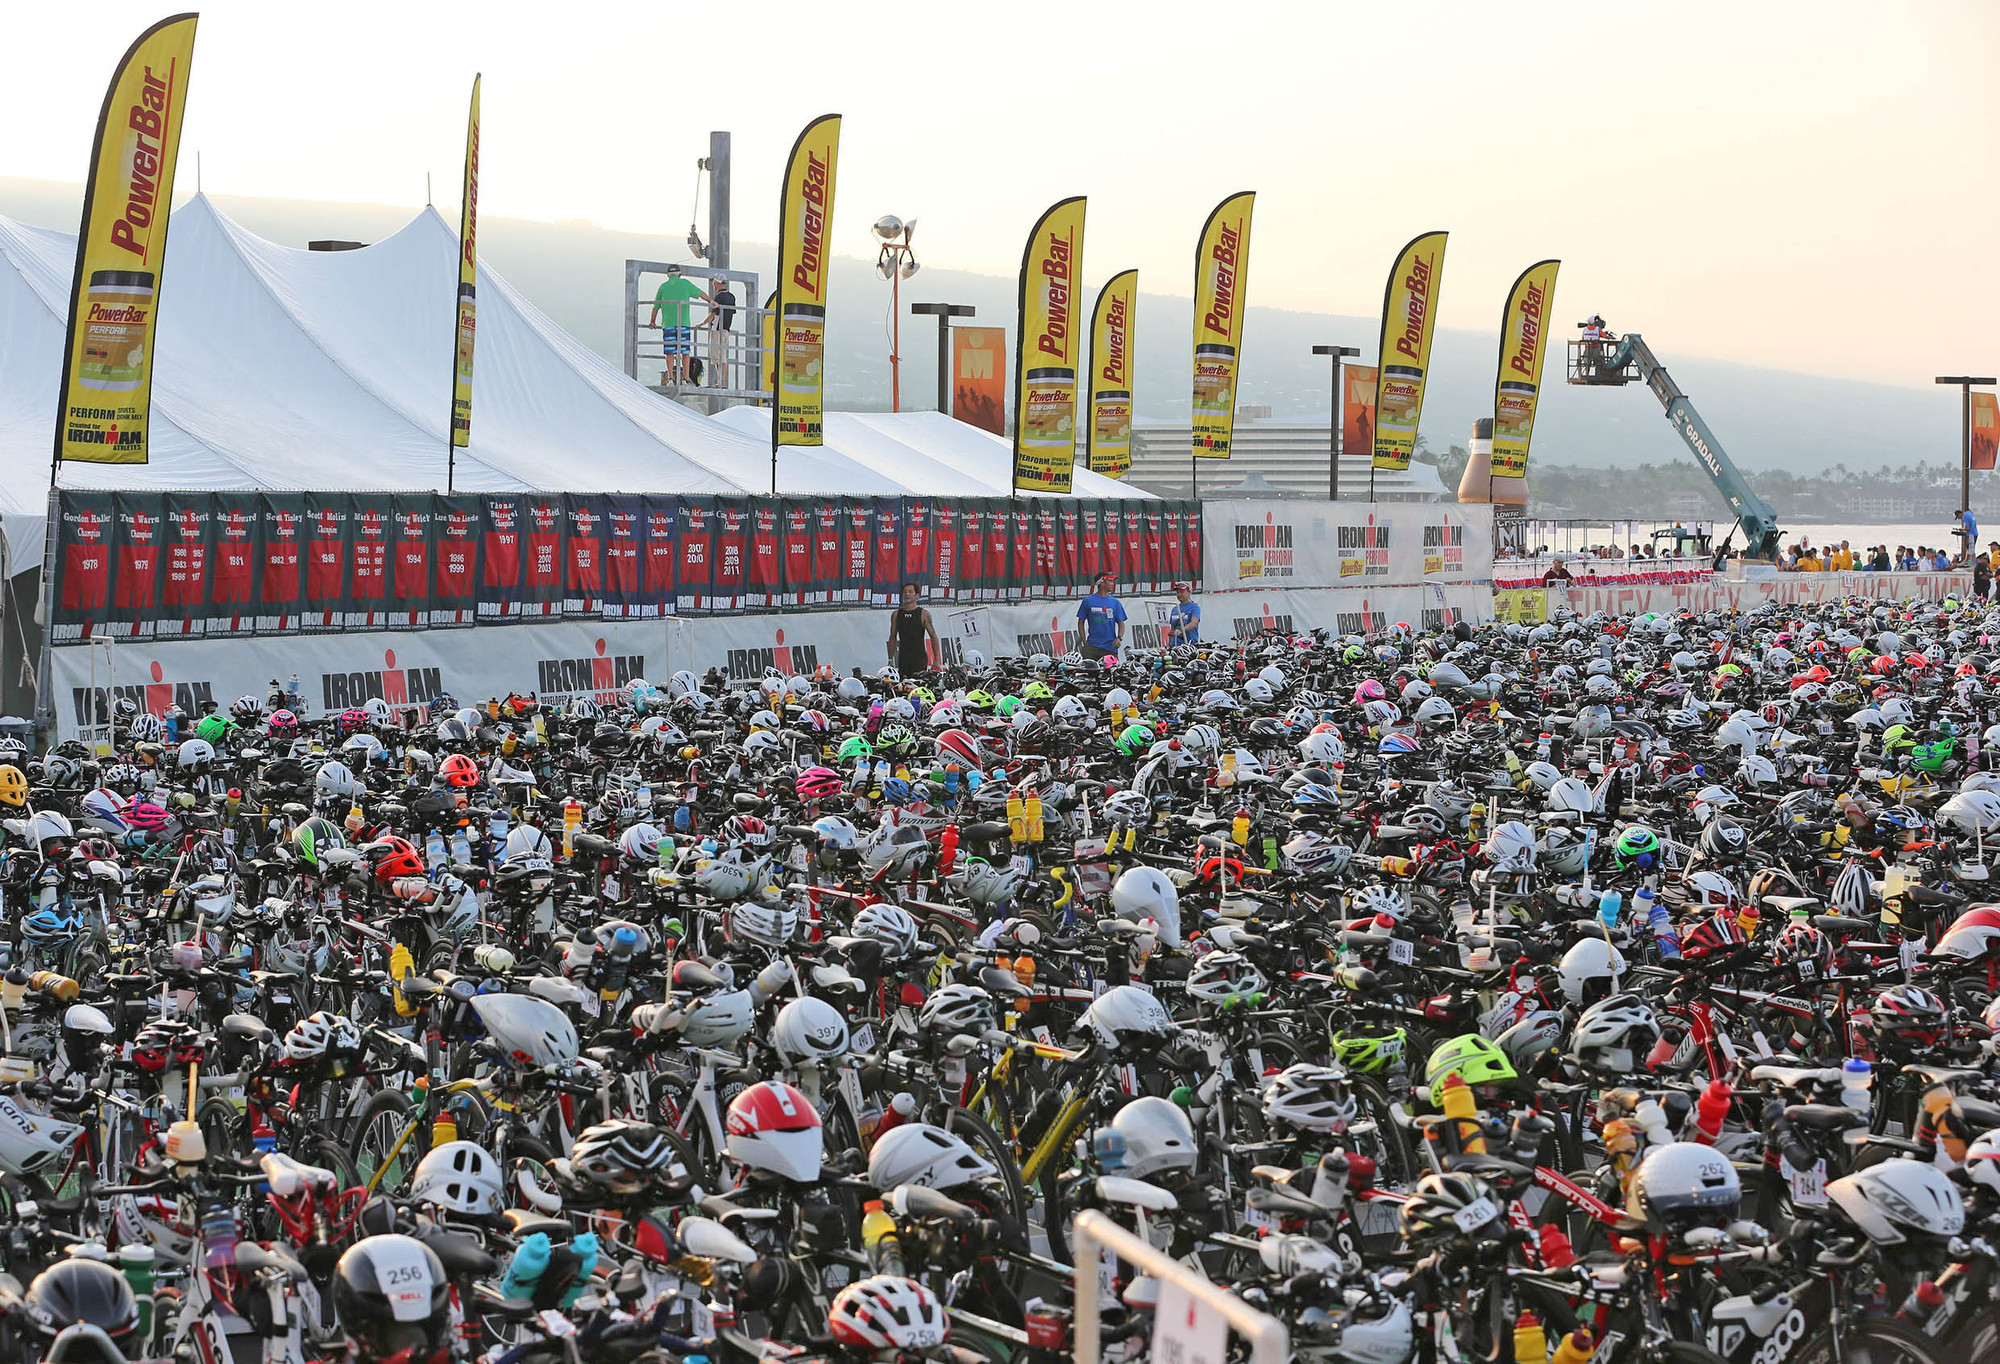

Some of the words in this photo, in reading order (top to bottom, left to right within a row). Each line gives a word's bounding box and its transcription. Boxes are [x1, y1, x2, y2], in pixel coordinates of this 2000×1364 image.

[111, 66, 166, 256] PowerBar
[794, 150, 826, 294] PowerBar
[1205, 221, 1237, 336] PowerBar
[1039, 232, 1070, 358] PowerBar
[88, 303, 148, 323] PowerBar
[1396, 255, 1429, 360] PowerBar
[89, 325, 126, 335] PERFORM
[784, 327, 820, 343] PowerBar
[1511, 281, 1542, 377] PowerBar
[1103, 294, 1125, 384] PowerBar
[1384, 382, 1418, 395] PowerBar
[1028, 390, 1071, 402] PowerBar
[1500, 396, 1531, 409] PowerBar
[70, 407, 116, 420] PERFORM
[1096, 407, 1127, 415] PowerBar
[68, 424, 142, 445] IRONMAN
[1686, 424, 1721, 477] GRADALL
[1019, 453, 1050, 465] PERFORM
[1016, 467, 1070, 482] IRONMAN
[1092, 462, 1129, 473] IRONMAN
[64, 512, 88, 523] Gordon
[120, 513, 135, 523] Tom
[169, 511, 188, 522] Dave
[190, 512, 210, 522] Scott
[306, 510, 323, 521] Scott
[354, 513, 370, 521] Mark
[395, 514, 411, 525] Greg
[1235, 511, 1293, 549] IRONMAN
[1337, 513, 1389, 548] IRONMAN
[1423, 513, 1462, 547] IRONMAN
[499, 535, 514, 544] 1997
[758, 545, 772, 555] 2012
[791, 544, 804, 554] 2012
[851, 550, 865, 559] 2008
[83, 559, 98, 570] 1978
[134, 559, 148, 570] 1979
[229, 555, 244, 566] 1981
[852, 559, 865, 569] 2009
[1264, 550, 1293, 566] PERFORM
[1424, 557, 1443, 573] PowerBar
[448, 564, 464, 574] 1999
[538, 564, 552, 573] 2003
[723, 565, 740, 576] 2011
[851, 569, 865, 578] 2011
[1239, 560, 1263, 577] PowerBar
[1340, 560, 1364, 576] PowerBar
[1233, 603, 1294, 639] IRONMAN
[1336, 599, 1387, 635] IRONMAN
[727, 628, 819, 681] IRONMAN
[538, 637, 645, 693] IRONMAN
[321, 648, 444, 709] IRONMAN
[749, 836, 762, 844] 631
[1726, 829, 1739, 838] 541
[1376, 898, 1392, 910] 485
[816, 1026, 836, 1041] 397
[1699, 1163, 1725, 1177] 262
[1800, 1178, 1816, 1197] 264
[1867, 1186, 1930, 1228] LAZER
[1464, 1206, 1491, 1226] 261
[388, 1266, 422, 1284] 256
[400, 1291, 422, 1301] BELL
[906, 1330, 936, 1348] 258
